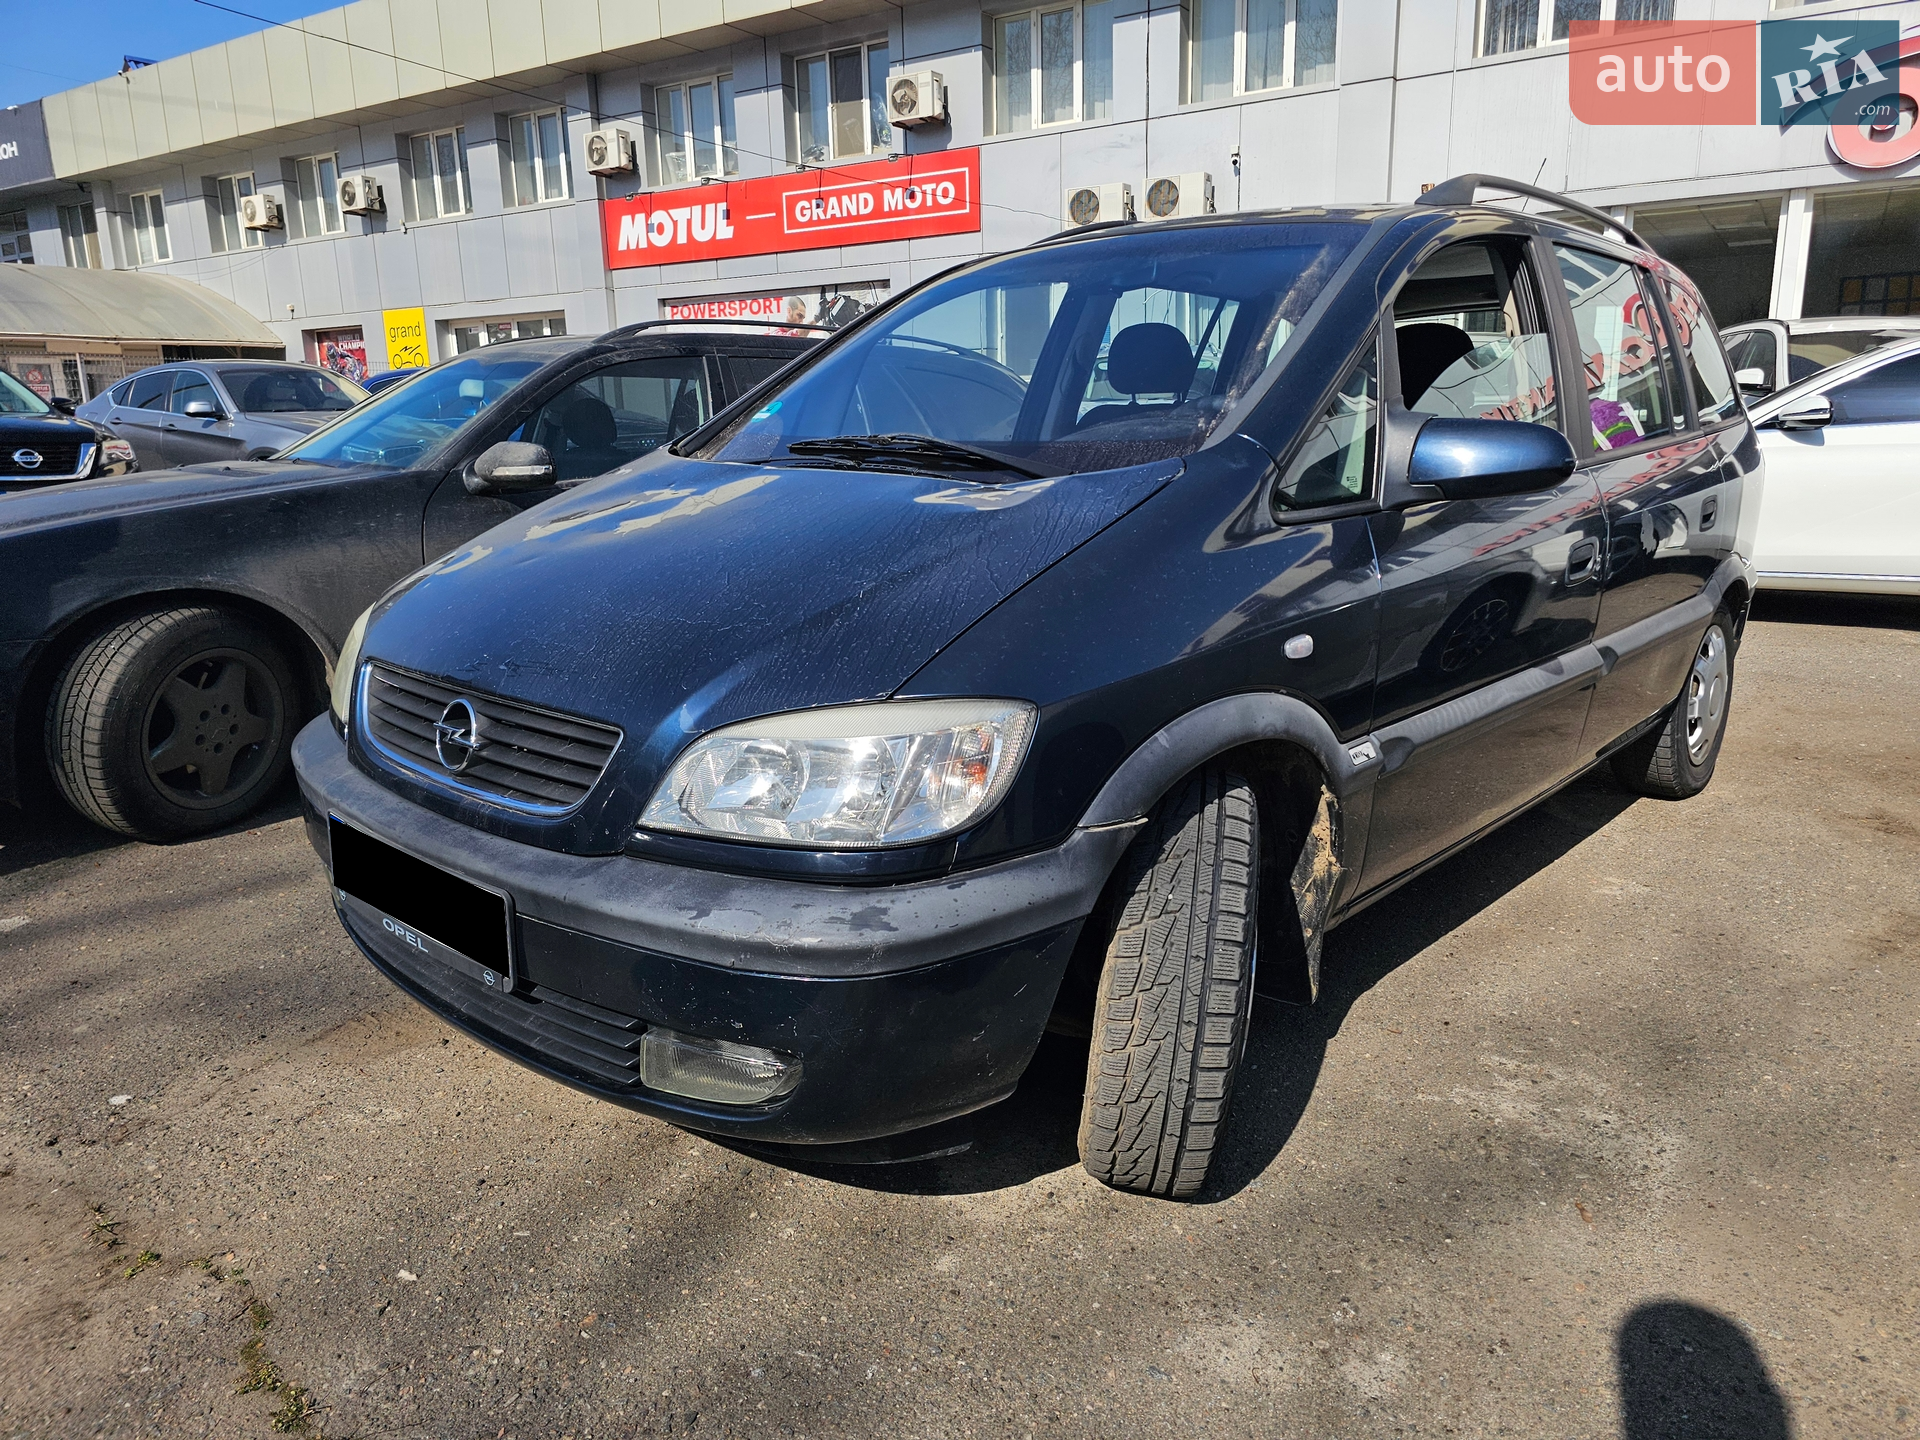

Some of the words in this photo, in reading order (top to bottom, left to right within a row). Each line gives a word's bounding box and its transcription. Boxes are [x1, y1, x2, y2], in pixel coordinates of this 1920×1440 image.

[618, 203, 734, 251] MOTUL
[795, 192, 874, 222] GRAND
[884, 181, 955, 211] MOTO
[670, 297, 783, 320] POWERSPORT
[389, 321, 421, 343] grand
[382, 918, 429, 953] OPEL
